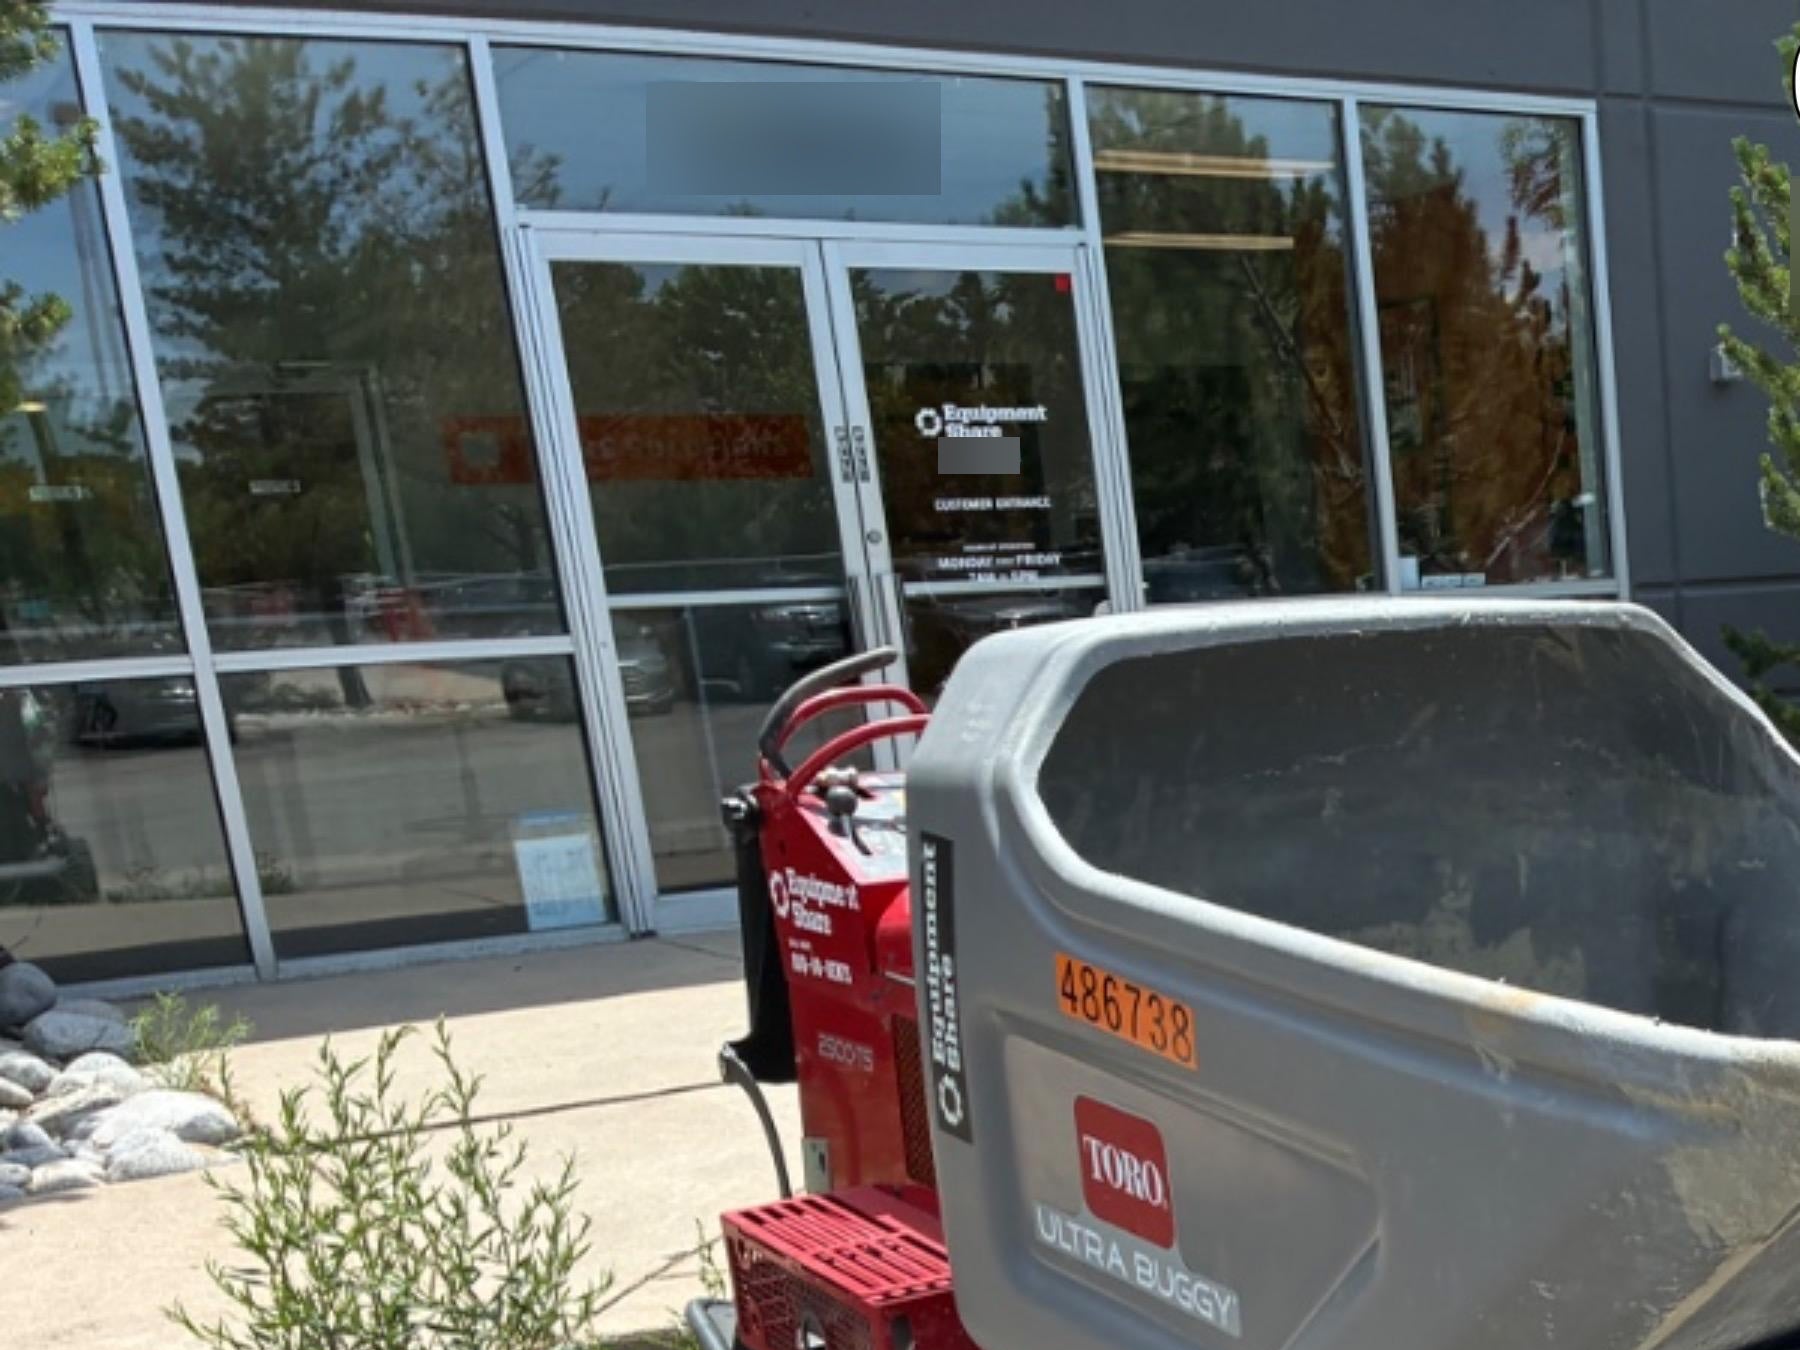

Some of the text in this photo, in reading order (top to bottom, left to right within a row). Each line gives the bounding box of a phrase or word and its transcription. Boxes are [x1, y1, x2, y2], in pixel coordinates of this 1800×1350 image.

[942, 404, 1047, 424] Equipment
[923, 842, 946, 1065] Equipment
[941, 953, 961, 1072] Share
[1061, 958, 1193, 1065] 486738
[1082, 1134, 1165, 1207] TORO
[1036, 1204, 1231, 1330] ULTRA BUGGY
